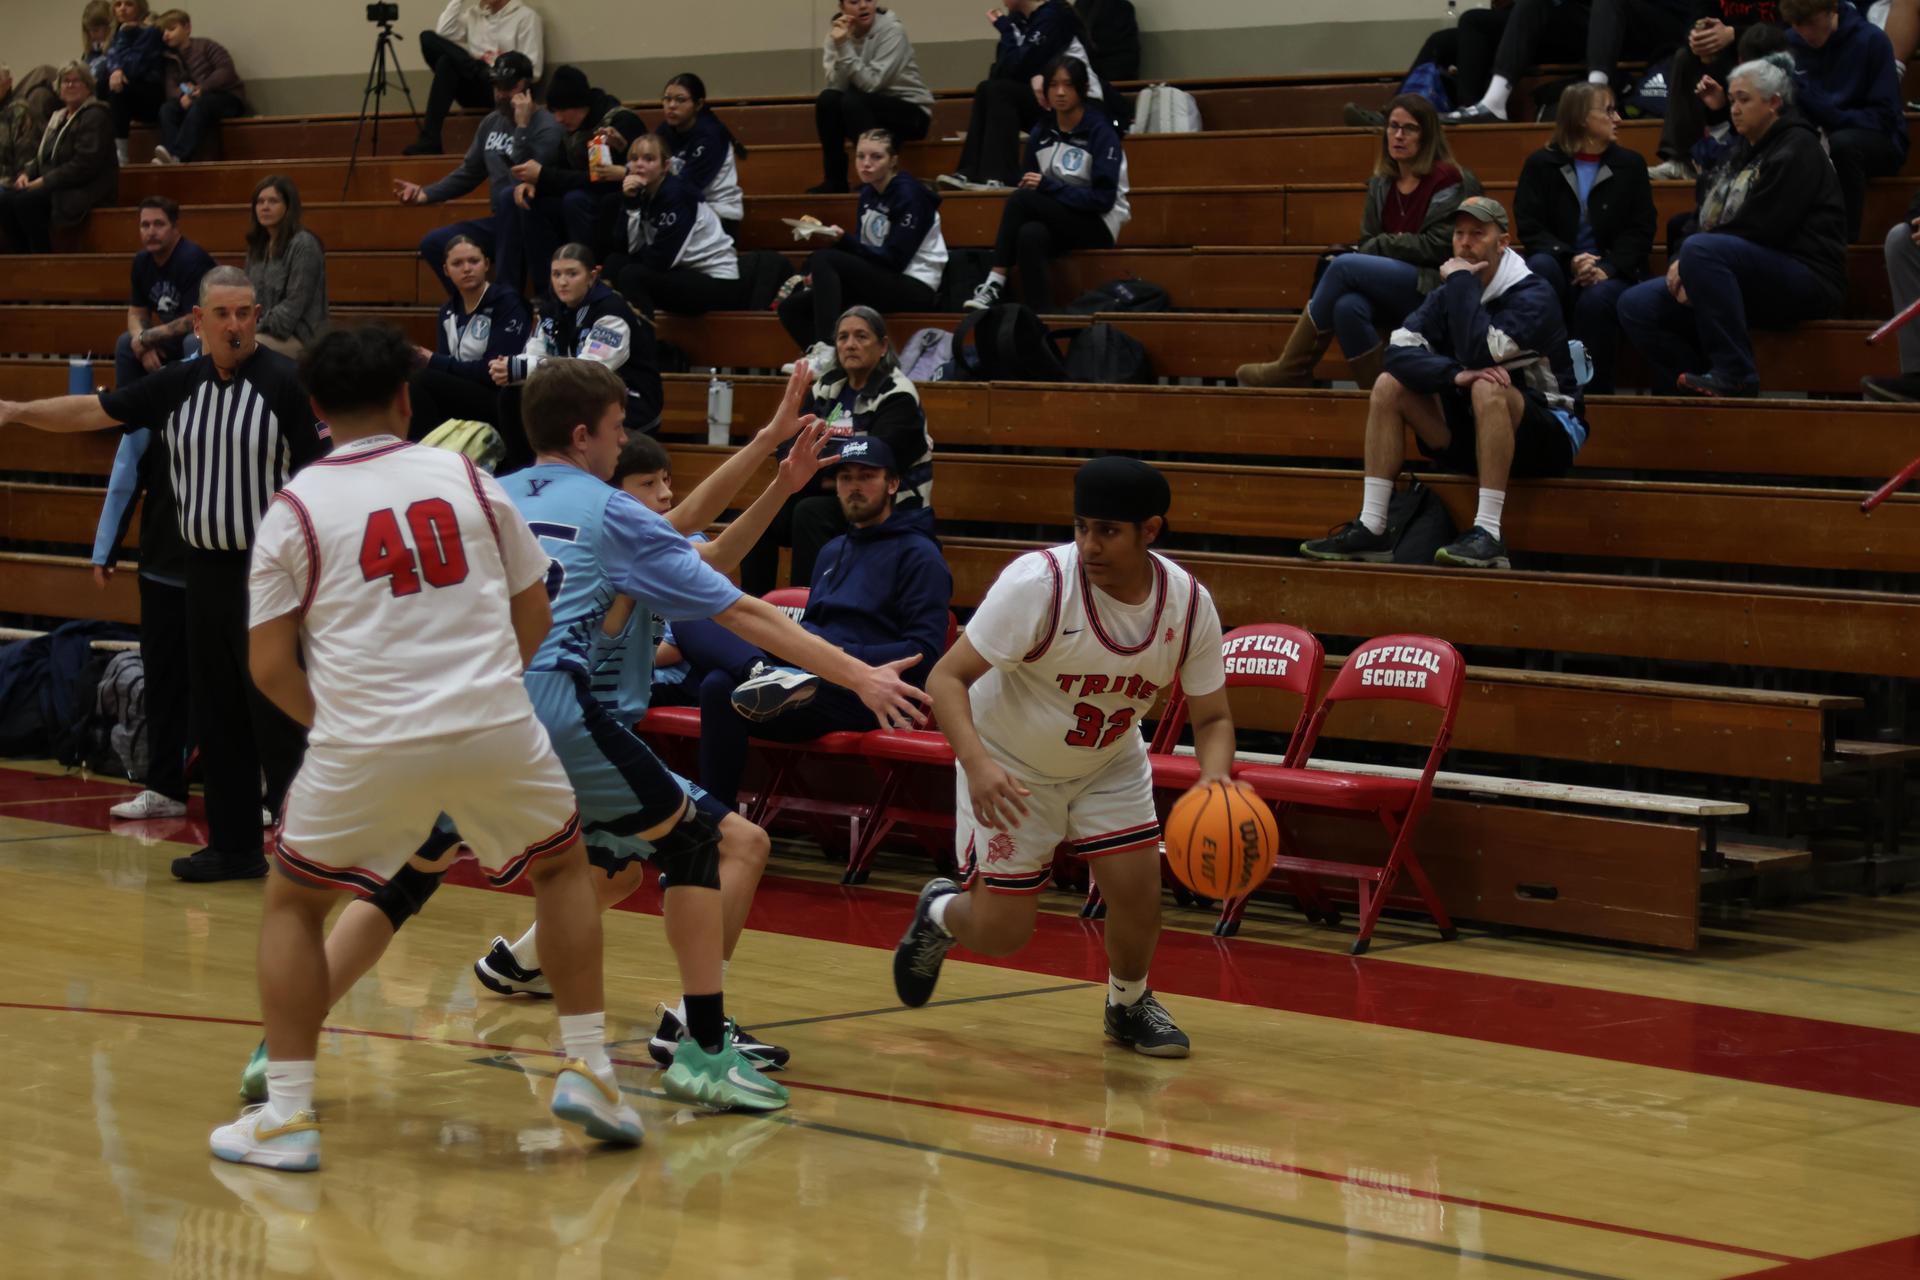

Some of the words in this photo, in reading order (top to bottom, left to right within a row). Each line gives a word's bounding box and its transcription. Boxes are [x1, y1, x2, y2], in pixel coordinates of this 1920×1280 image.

[658, 211, 677, 226] 20
[527, 479, 552, 497] Y
[359, 497, 470, 598] 40
[1222, 635, 1300, 662] OFFICIAL
[1355, 646, 1441, 674] OFFICIAL
[1224, 658, 1288, 676] SCORER
[1362, 669, 1428, 689] SCORER
[1064, 702, 1136, 749] 32
